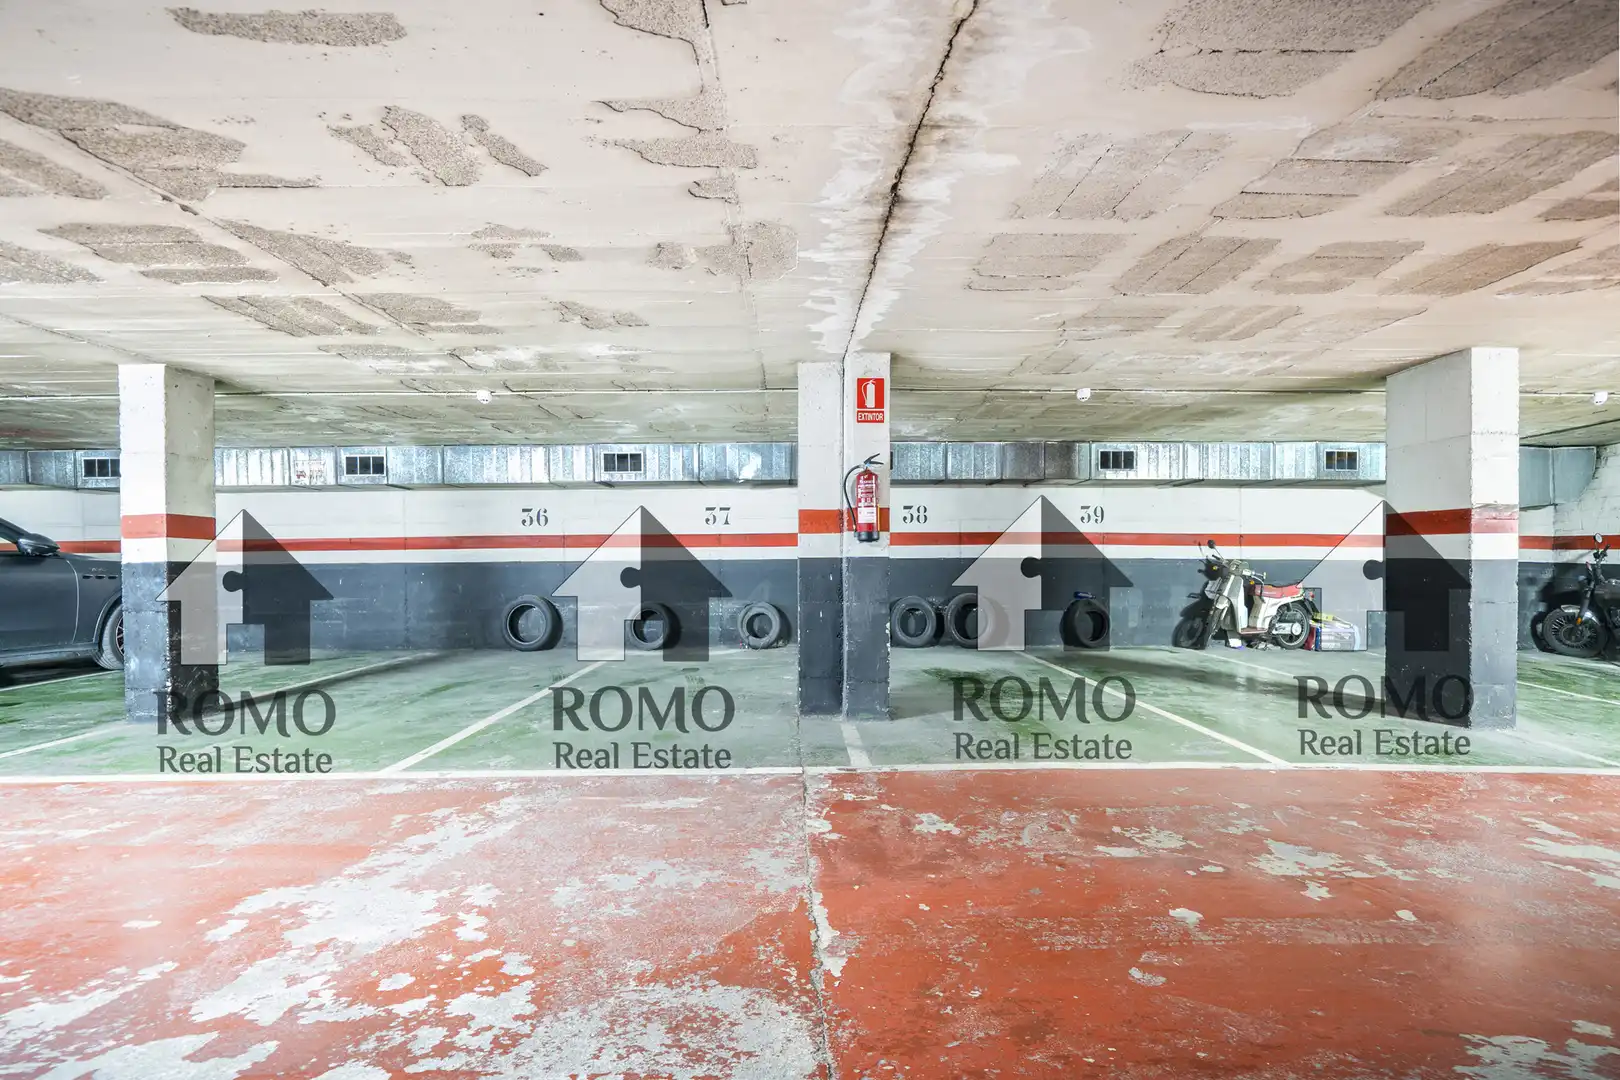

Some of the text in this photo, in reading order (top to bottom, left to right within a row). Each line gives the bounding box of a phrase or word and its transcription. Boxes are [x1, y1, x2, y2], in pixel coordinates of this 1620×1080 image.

[858, 412, 884, 422] EXTINTOR
[521, 508, 549, 527] 36
[705, 506, 731, 526] 37
[902, 505, 928, 524] 38
[1080, 505, 1106, 524] 39
